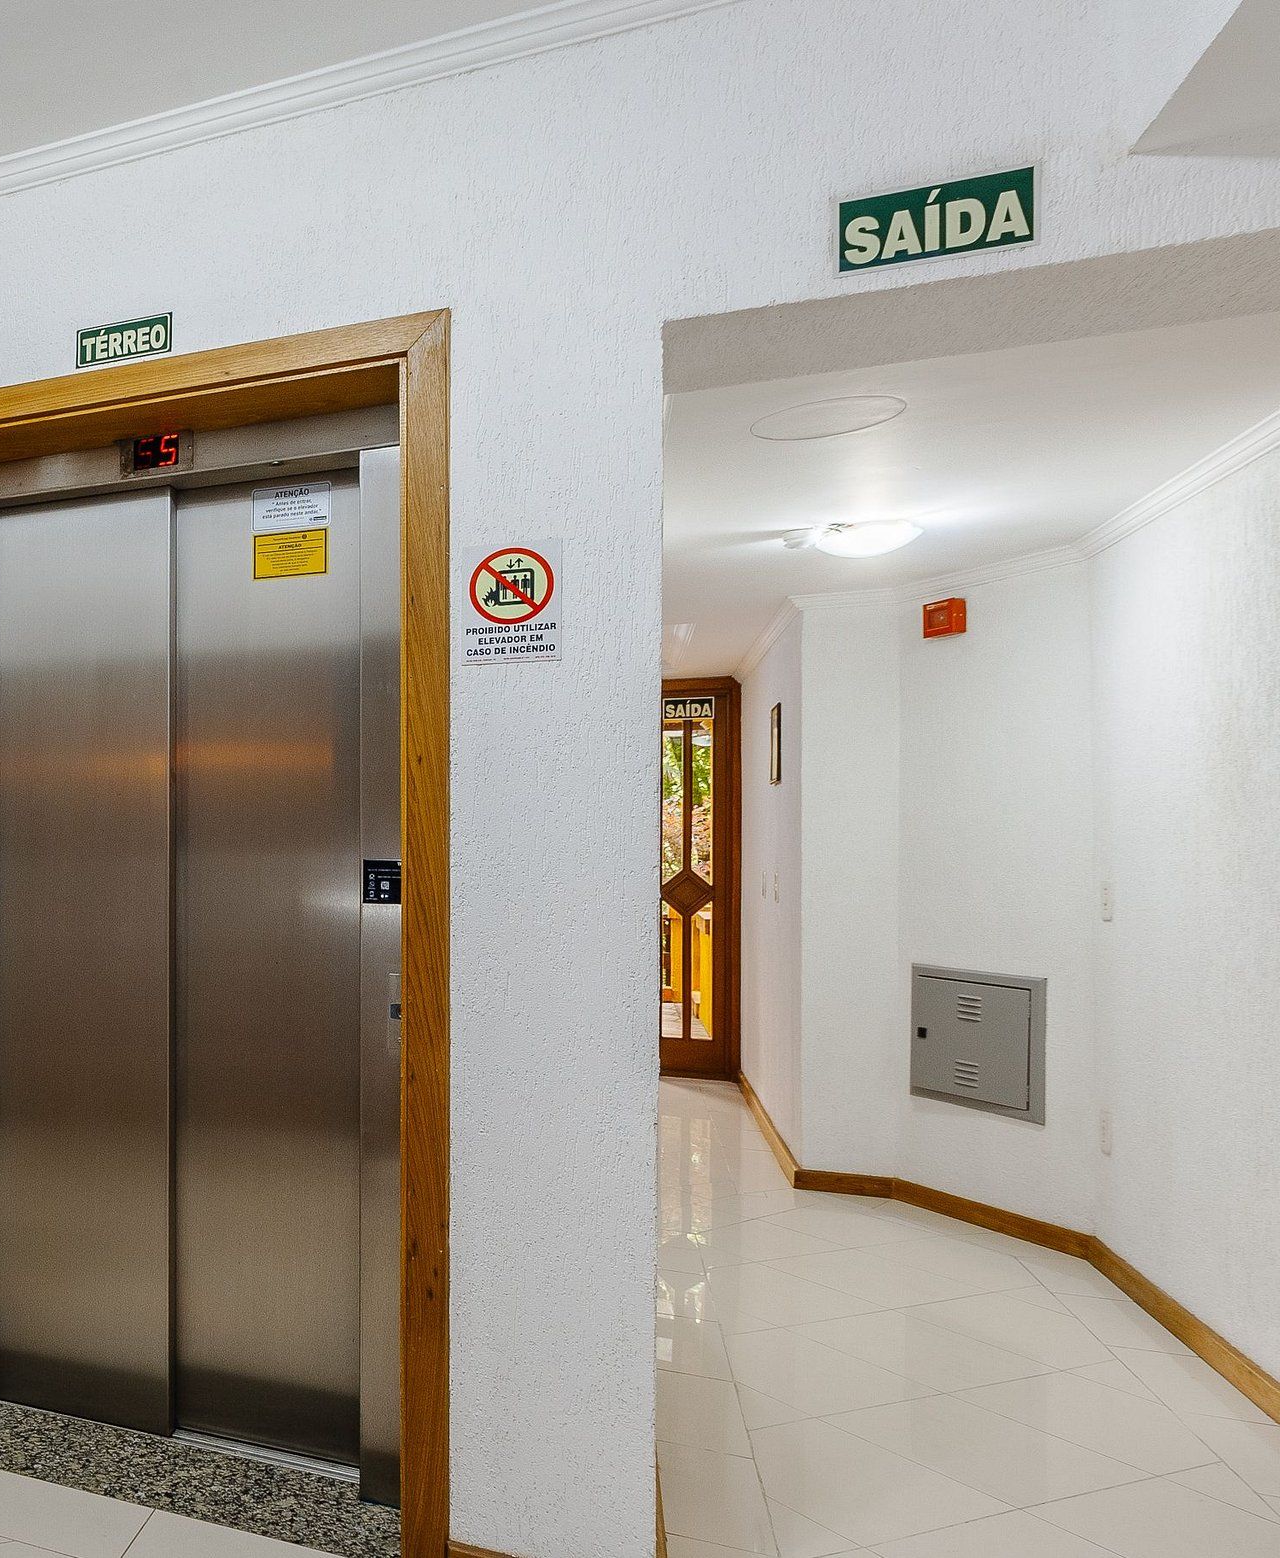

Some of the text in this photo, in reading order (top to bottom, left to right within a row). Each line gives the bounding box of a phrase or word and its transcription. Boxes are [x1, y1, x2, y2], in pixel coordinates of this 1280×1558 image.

[844, 188, 1030, 265] SAÍDA
[82, 324, 166, 362] TÉRREO
[274, 488, 310, 499] ATENÇÃO
[465, 622, 557, 635] PROIBIDO UTILIZAR
[478, 634, 544, 645] ELEVADOR EM
[466, 648, 491, 656] CASO
[494, 646, 506, 655] DE
[665, 699, 712, 718] SAÍDA
